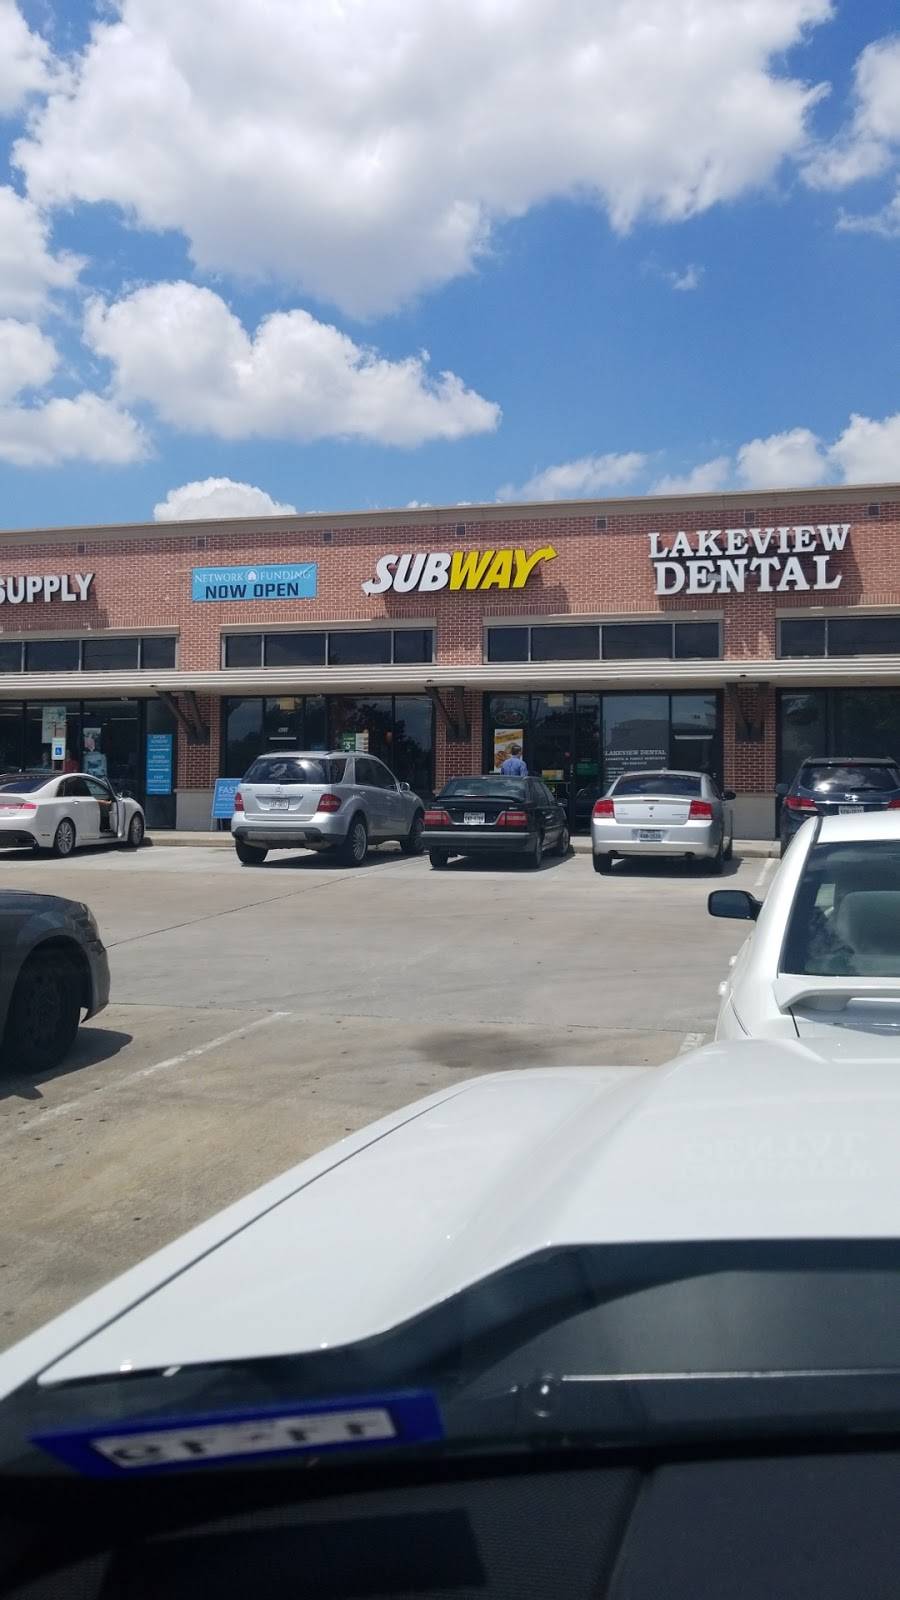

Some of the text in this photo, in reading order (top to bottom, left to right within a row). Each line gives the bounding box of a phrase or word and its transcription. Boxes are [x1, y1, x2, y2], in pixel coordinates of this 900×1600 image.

[648, 524, 851, 559] LAKEVIEW
[194, 569, 311, 583] NETWORK FUNDING
[361, 545, 559, 596] SUBWAY
[654, 555, 842, 595] DENTAL
[205, 582, 299, 599] NOW OPEN
